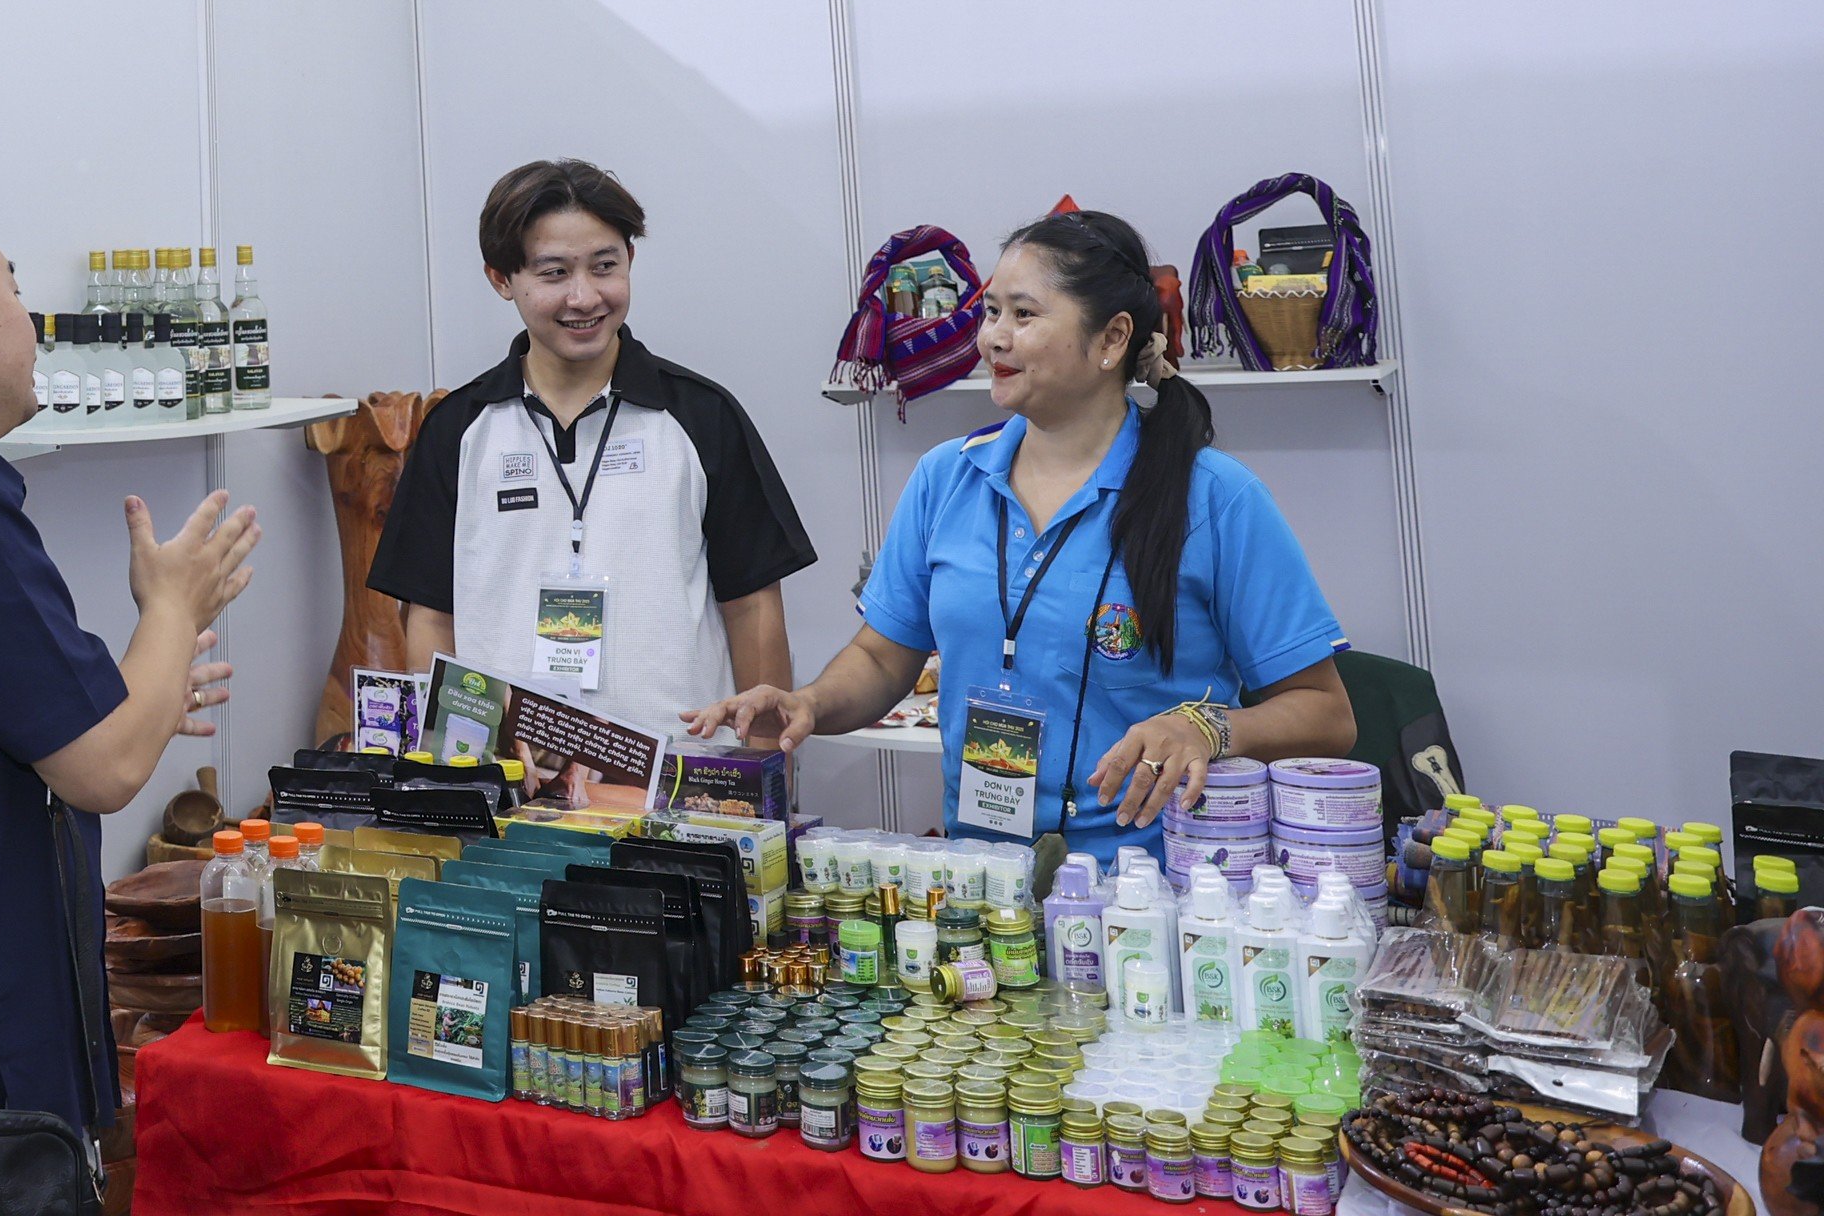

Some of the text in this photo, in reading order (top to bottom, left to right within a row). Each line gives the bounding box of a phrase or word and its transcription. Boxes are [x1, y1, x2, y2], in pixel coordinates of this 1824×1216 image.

[547, 656, 572, 664] TRƯNG
[519, 714, 532, 723] đau
[556, 709, 570, 720] đau
[611, 732, 624, 741] sau
[624, 735, 636, 746] khi
[533, 737, 547, 746] đau
[577, 727, 591, 737] đau
[613, 740, 627, 751] đau
[583, 747, 597, 757] Xoa
[598, 753, 612, 764] bóp
[701, 777, 714, 785] Ginger
[984, 780, 1012, 795] ĐƠN VỊ
[975, 789, 1020, 805] TRƯNG BÀY
[981, 802, 1012, 813] EXHIBITOR
[1204, 972, 1219, 980] BSK
[1267, 986, 1282, 994] BSK
